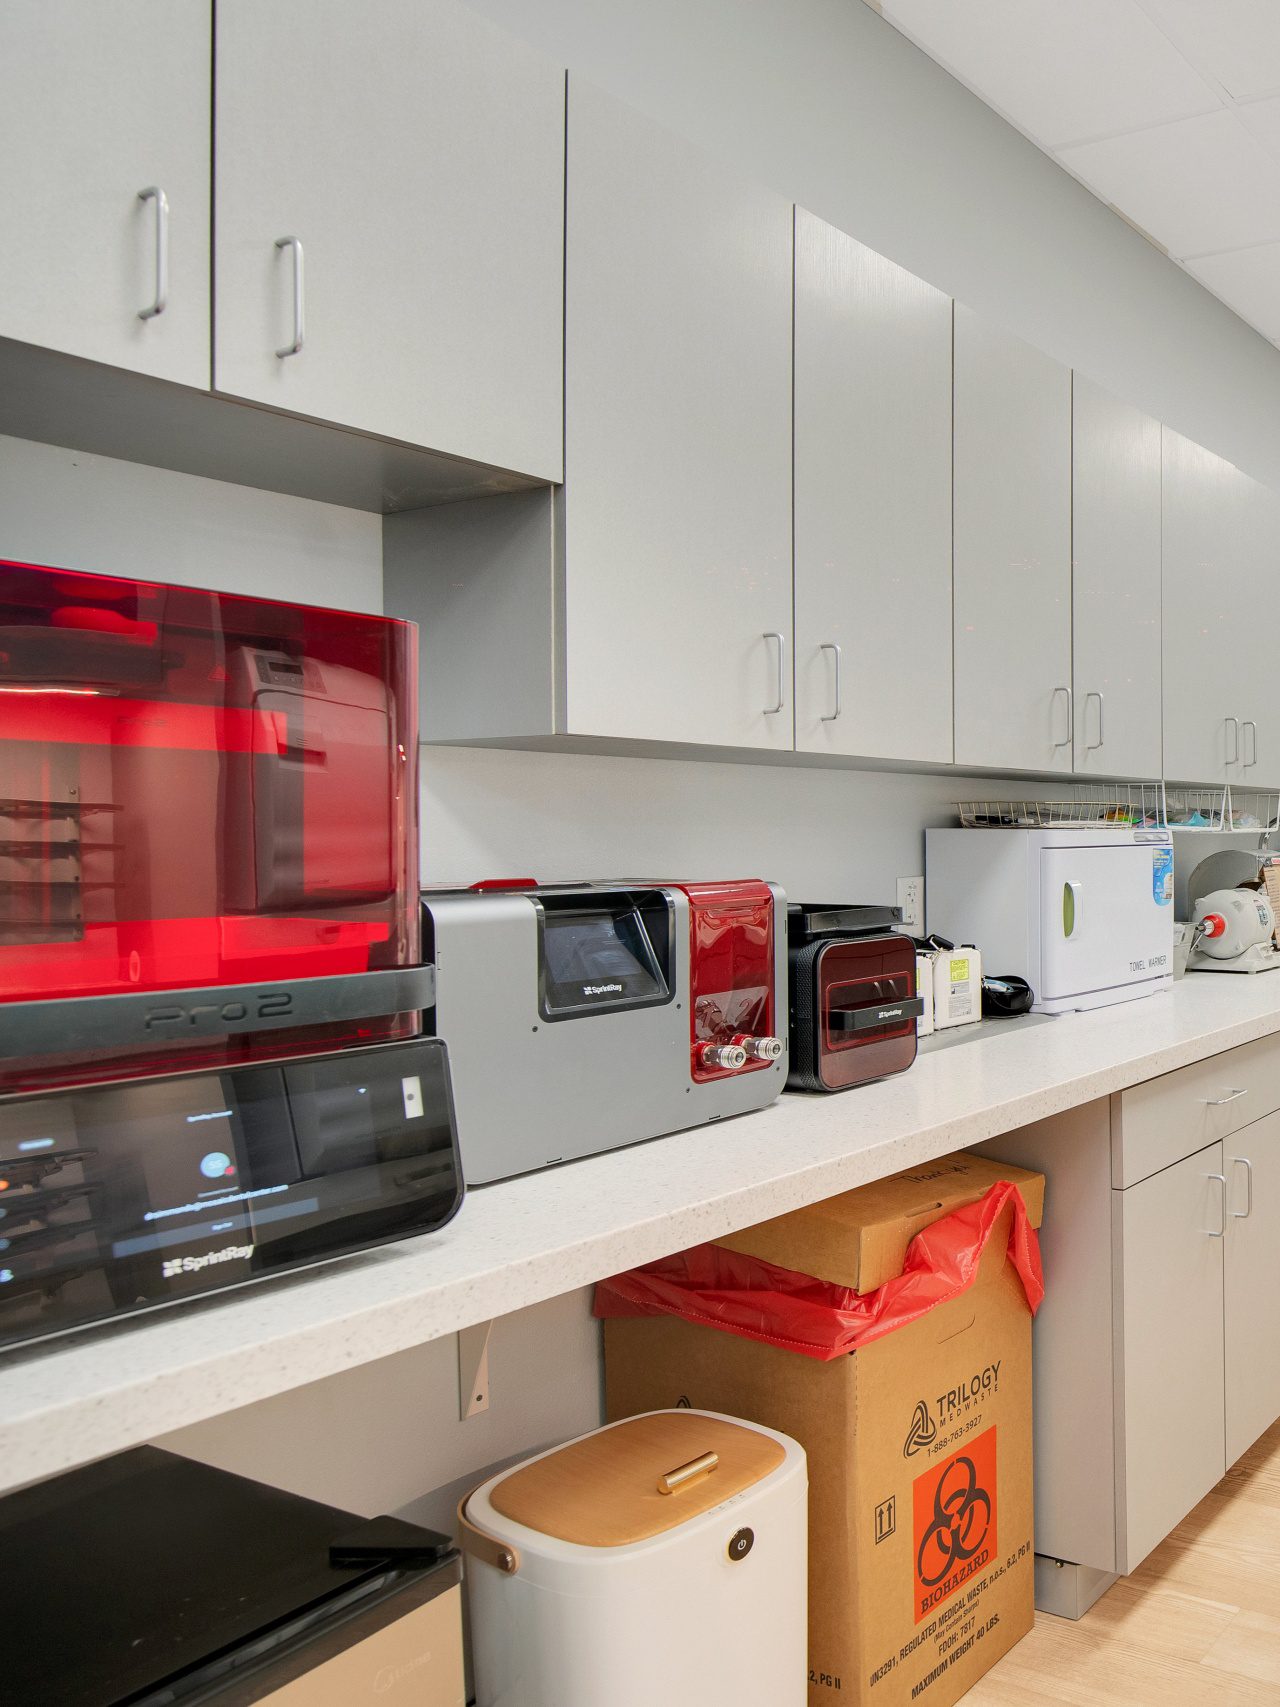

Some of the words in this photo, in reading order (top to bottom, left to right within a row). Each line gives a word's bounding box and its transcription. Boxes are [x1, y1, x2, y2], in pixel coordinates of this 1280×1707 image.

[182, 1244, 255, 1272] SprintRay
[936, 1359, 1001, 1417] TRILOGY
[939, 1383, 999, 1428] MEDWASTE
[927, 1414, 982, 1457] 1-888-763-3927
[920, 1549, 989, 1615] BIOHAZARD
[869, 1656, 899, 1688] UN3291,
[899, 1621, 937, 1662] REGULATED
[938, 1598, 966, 1629] MEDICAL
[966, 1578, 989, 1603] WASTE,
[1006, 1554, 1018, 1569] 6.2,
[1017, 1544, 1026, 1560] PG
[933, 1629, 945, 1644] (May
[945, 1614, 963, 1633] Contain
[963, 1599, 980, 1618] Sharps)
[938, 1632, 959, 1657] FDOH:
[960, 1616, 976, 1638] 7817
[911, 1658, 949, 1701] MAXIMUM
[948, 1634, 976, 1665] WEIGHT
[976, 1626, 985, 1640] 40
[985, 1613, 1000, 1633] LBS.
[820, 1672, 832, 1687] PG
[834, 1677, 841, 1690] II
